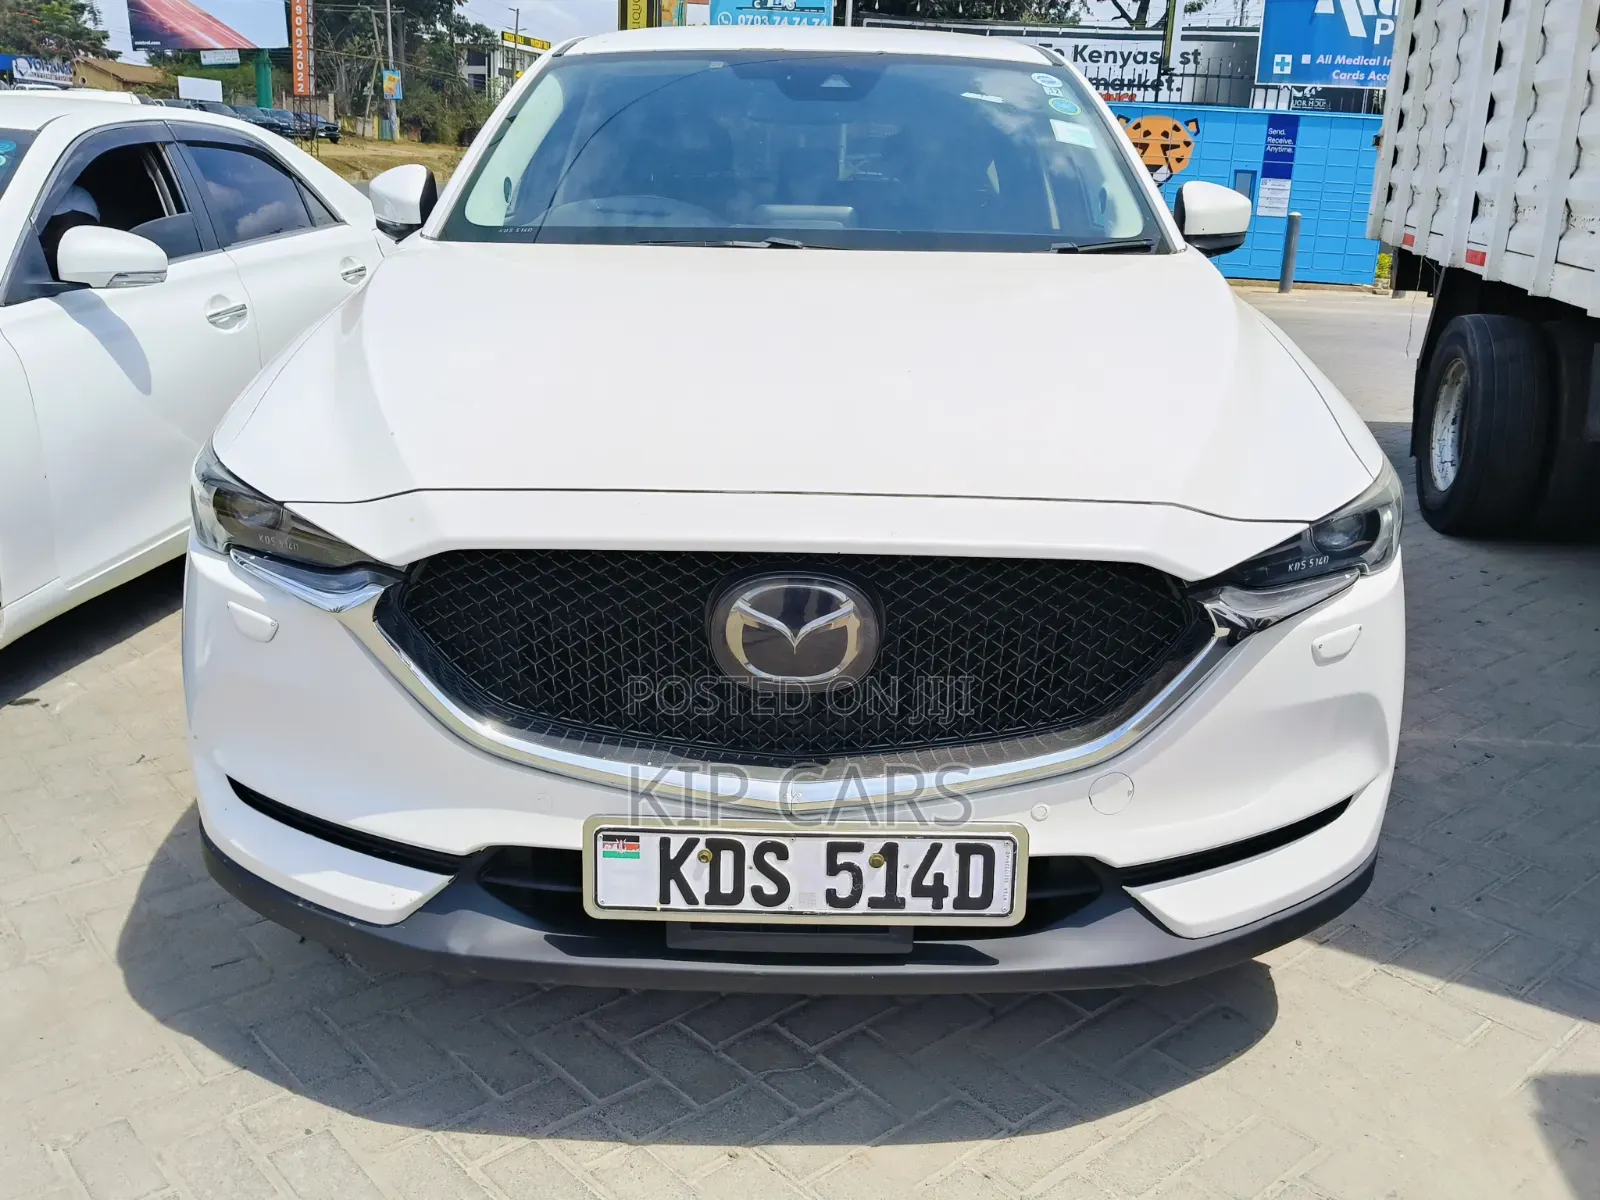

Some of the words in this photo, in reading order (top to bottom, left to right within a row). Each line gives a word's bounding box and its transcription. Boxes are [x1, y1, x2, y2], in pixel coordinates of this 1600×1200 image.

[738, 15, 769, 25] 0703
[1316, 55, 1333, 65] All
[1334, 54, 1380, 66] Medical
[1332, 69, 1365, 81] Cards
[1268, 127, 1286, 136] Send.
[1267, 136, 1294, 145] Receive.
[1266, 145, 1294, 154] Anytime.
[258, 534, 276, 546] KDS
[1288, 560, 1306, 572] KDS
[658, 836, 791, 907] KDS
[825, 840, 997, 910] 514D
